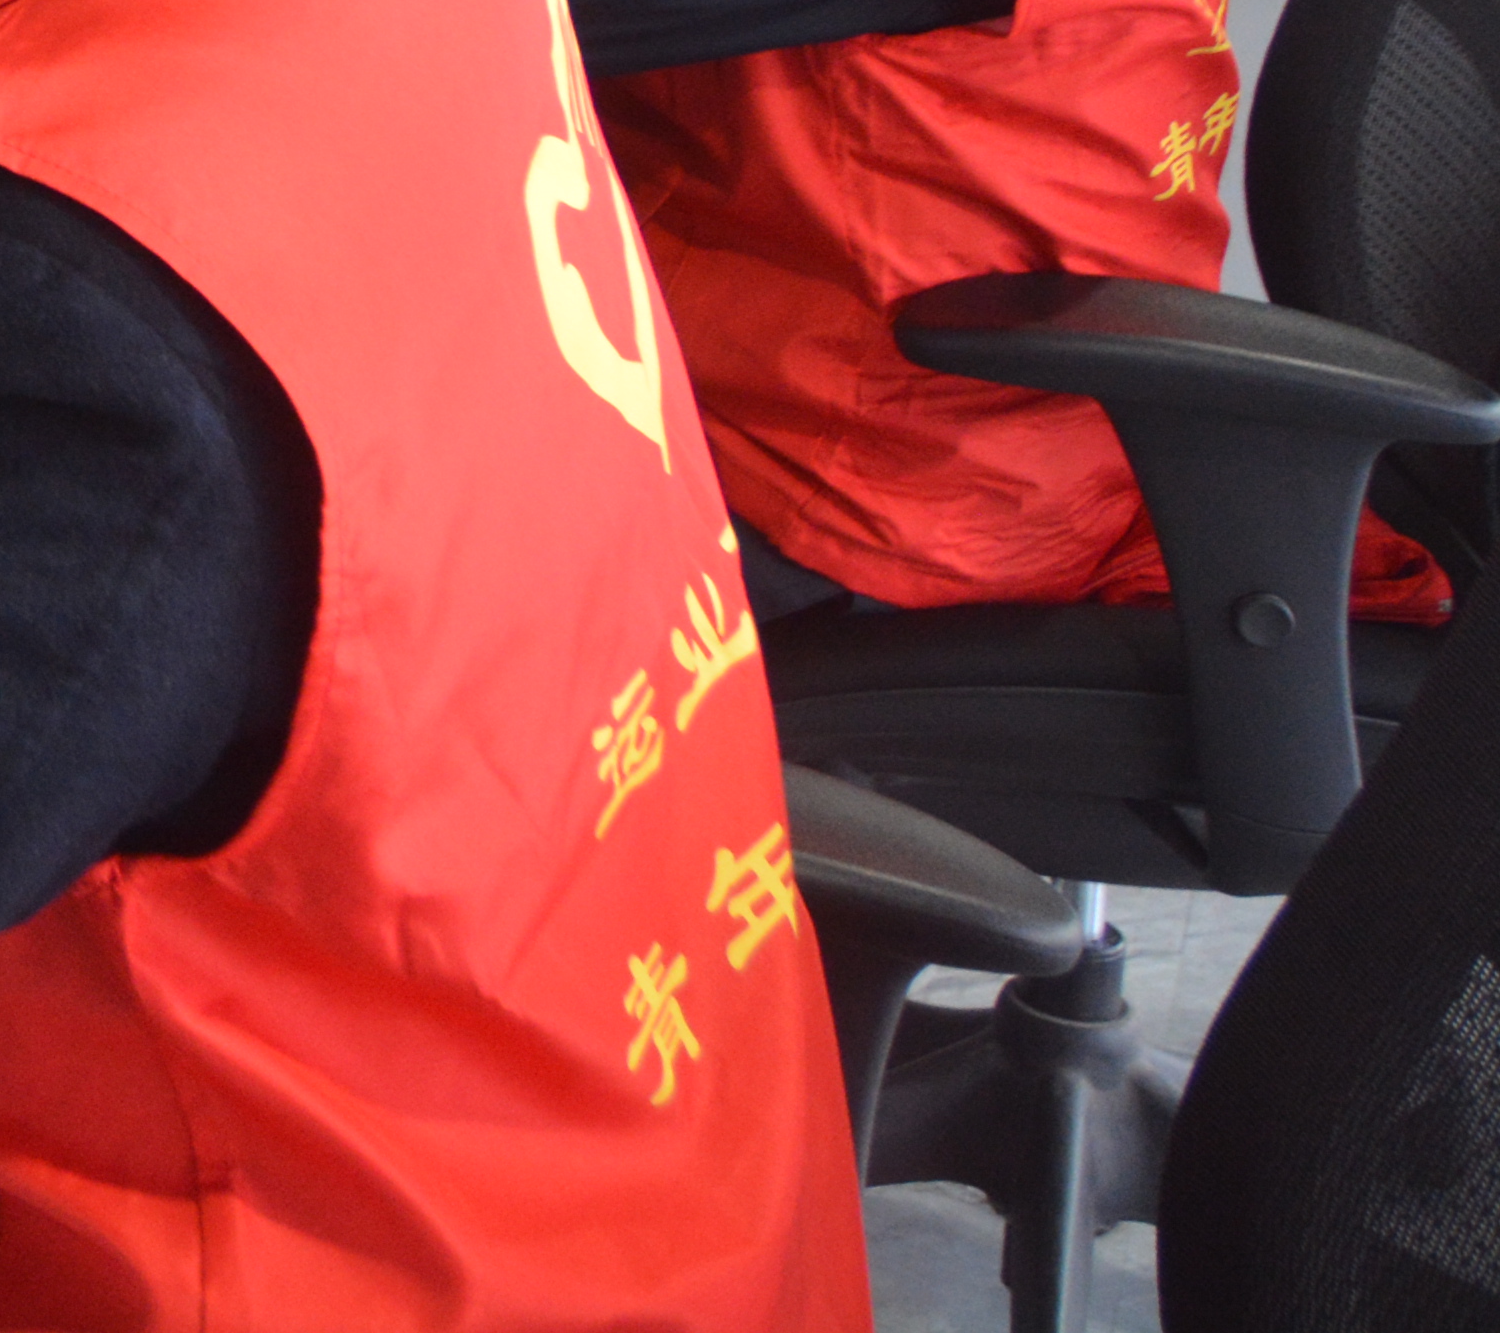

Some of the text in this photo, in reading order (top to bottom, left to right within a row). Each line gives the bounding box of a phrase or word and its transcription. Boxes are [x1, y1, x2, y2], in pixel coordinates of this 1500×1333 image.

[1150, 91, 1240, 202] 青年
[593, 526, 758, 838] 运业
[624, 822, 799, 1105] 青年
